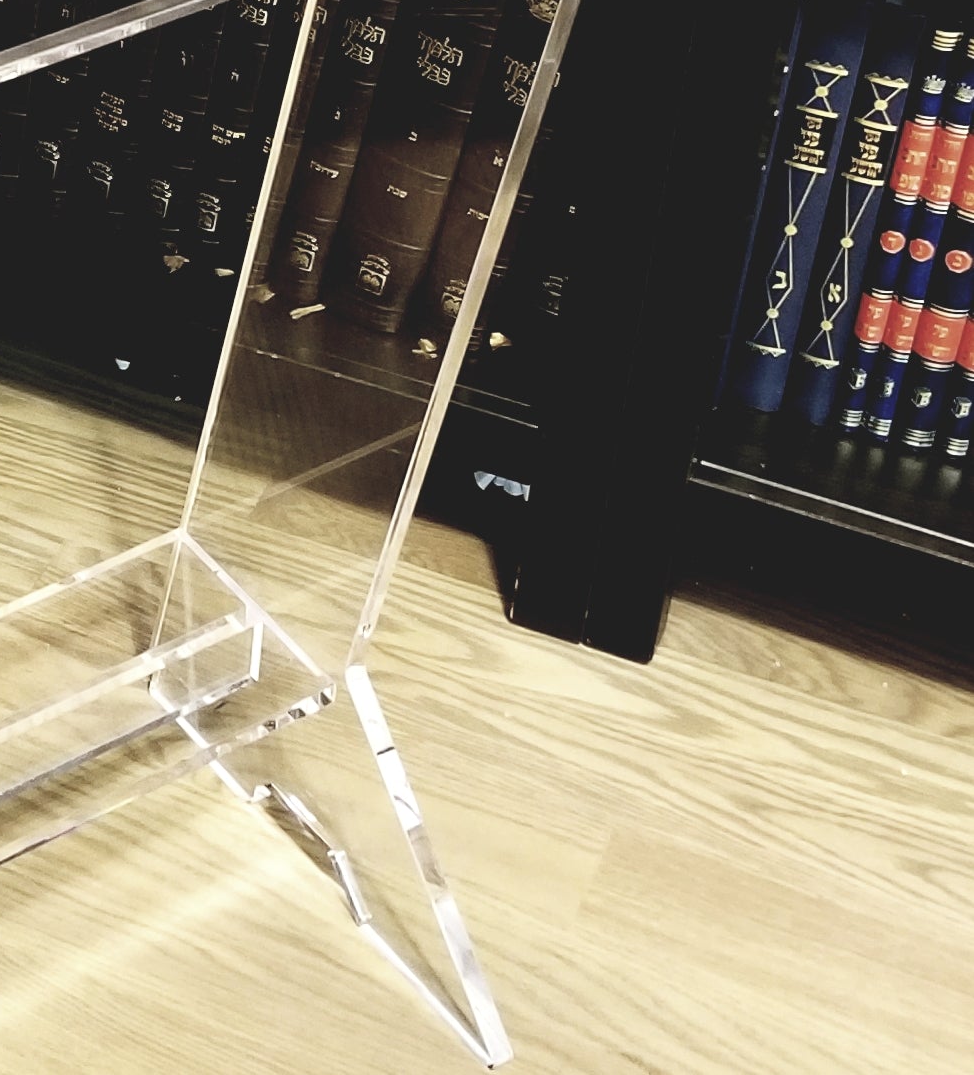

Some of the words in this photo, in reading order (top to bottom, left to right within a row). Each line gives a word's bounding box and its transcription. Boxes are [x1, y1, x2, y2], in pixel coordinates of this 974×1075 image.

[417, 30, 464, 67] תלמוד
[416, 56, 451, 86] בבלי
[386, 184, 408, 199] שבת
[828, 283, 842, 304] א
